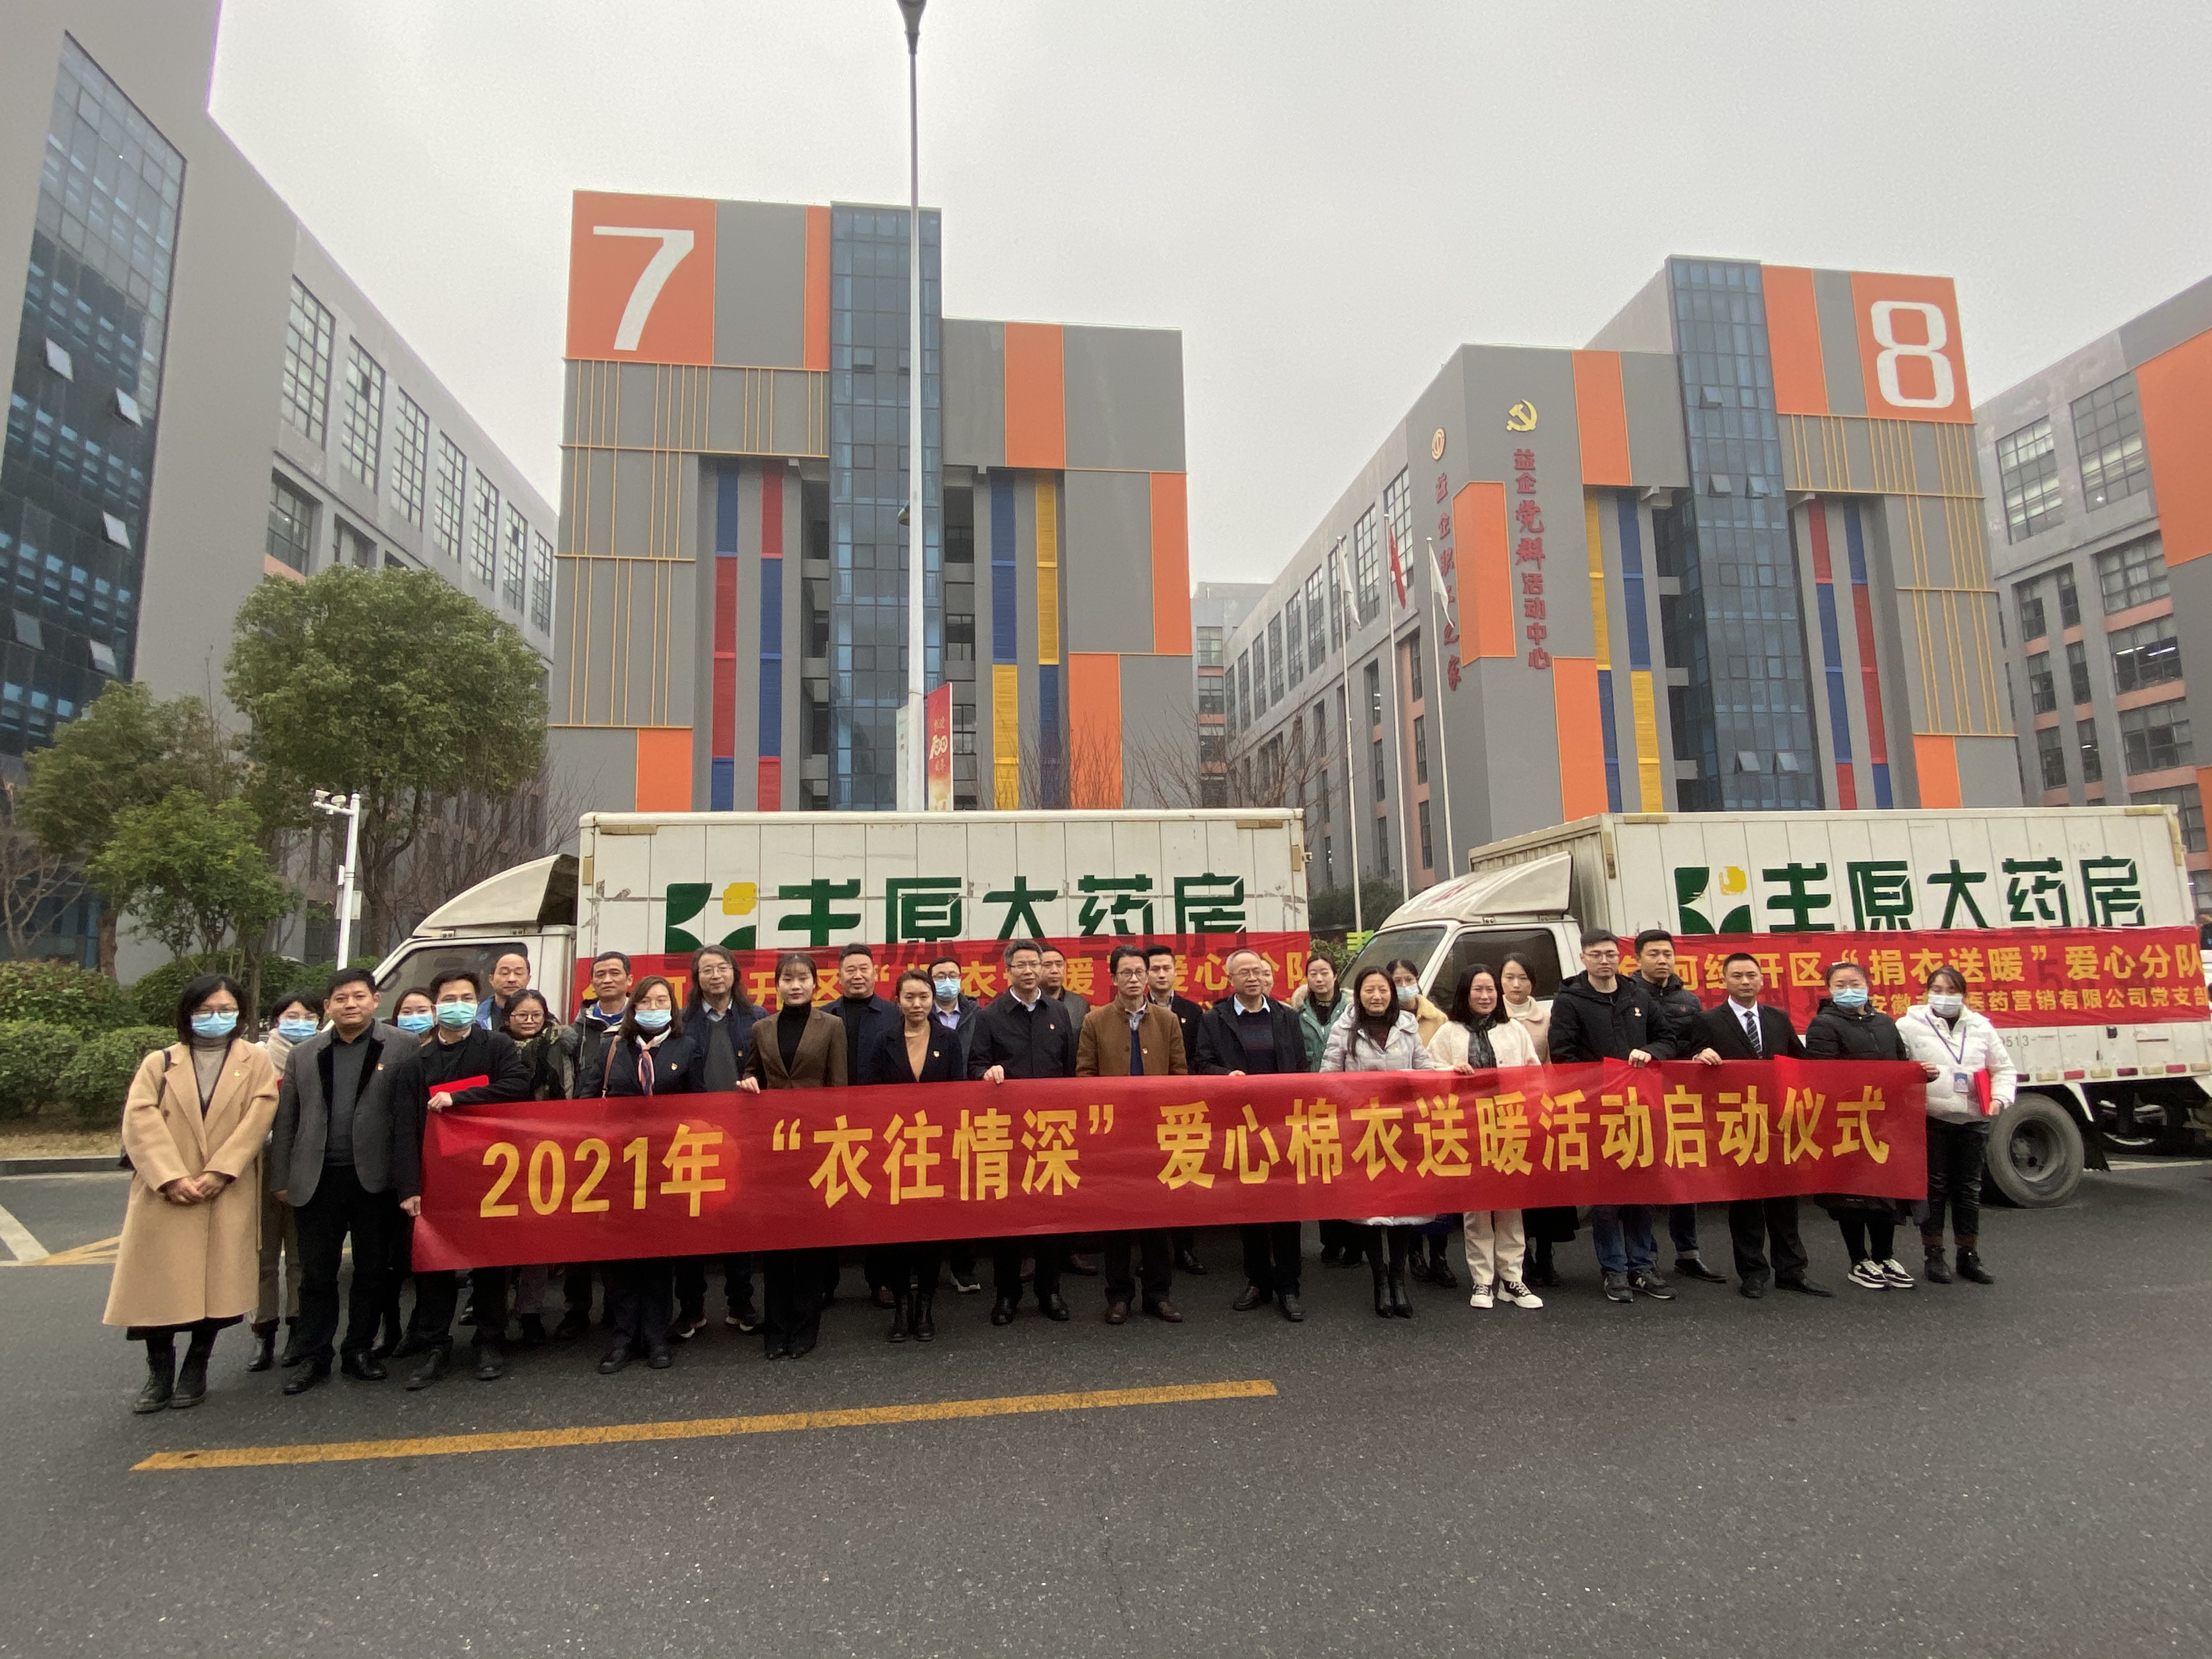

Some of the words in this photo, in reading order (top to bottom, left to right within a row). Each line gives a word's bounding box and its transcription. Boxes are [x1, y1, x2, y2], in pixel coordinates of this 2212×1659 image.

[593, 225, 694, 351] 7
[1871, 301, 1955, 408] 8
[1513, 448, 1550, 670] 益企党群活动中心
[778, 872, 1247, 948] 丰原大药房
[1762, 856, 2146, 932] 丰原大药房
[1869, 986, 2209, 1015] 安徽医药营销有限公司党支部
